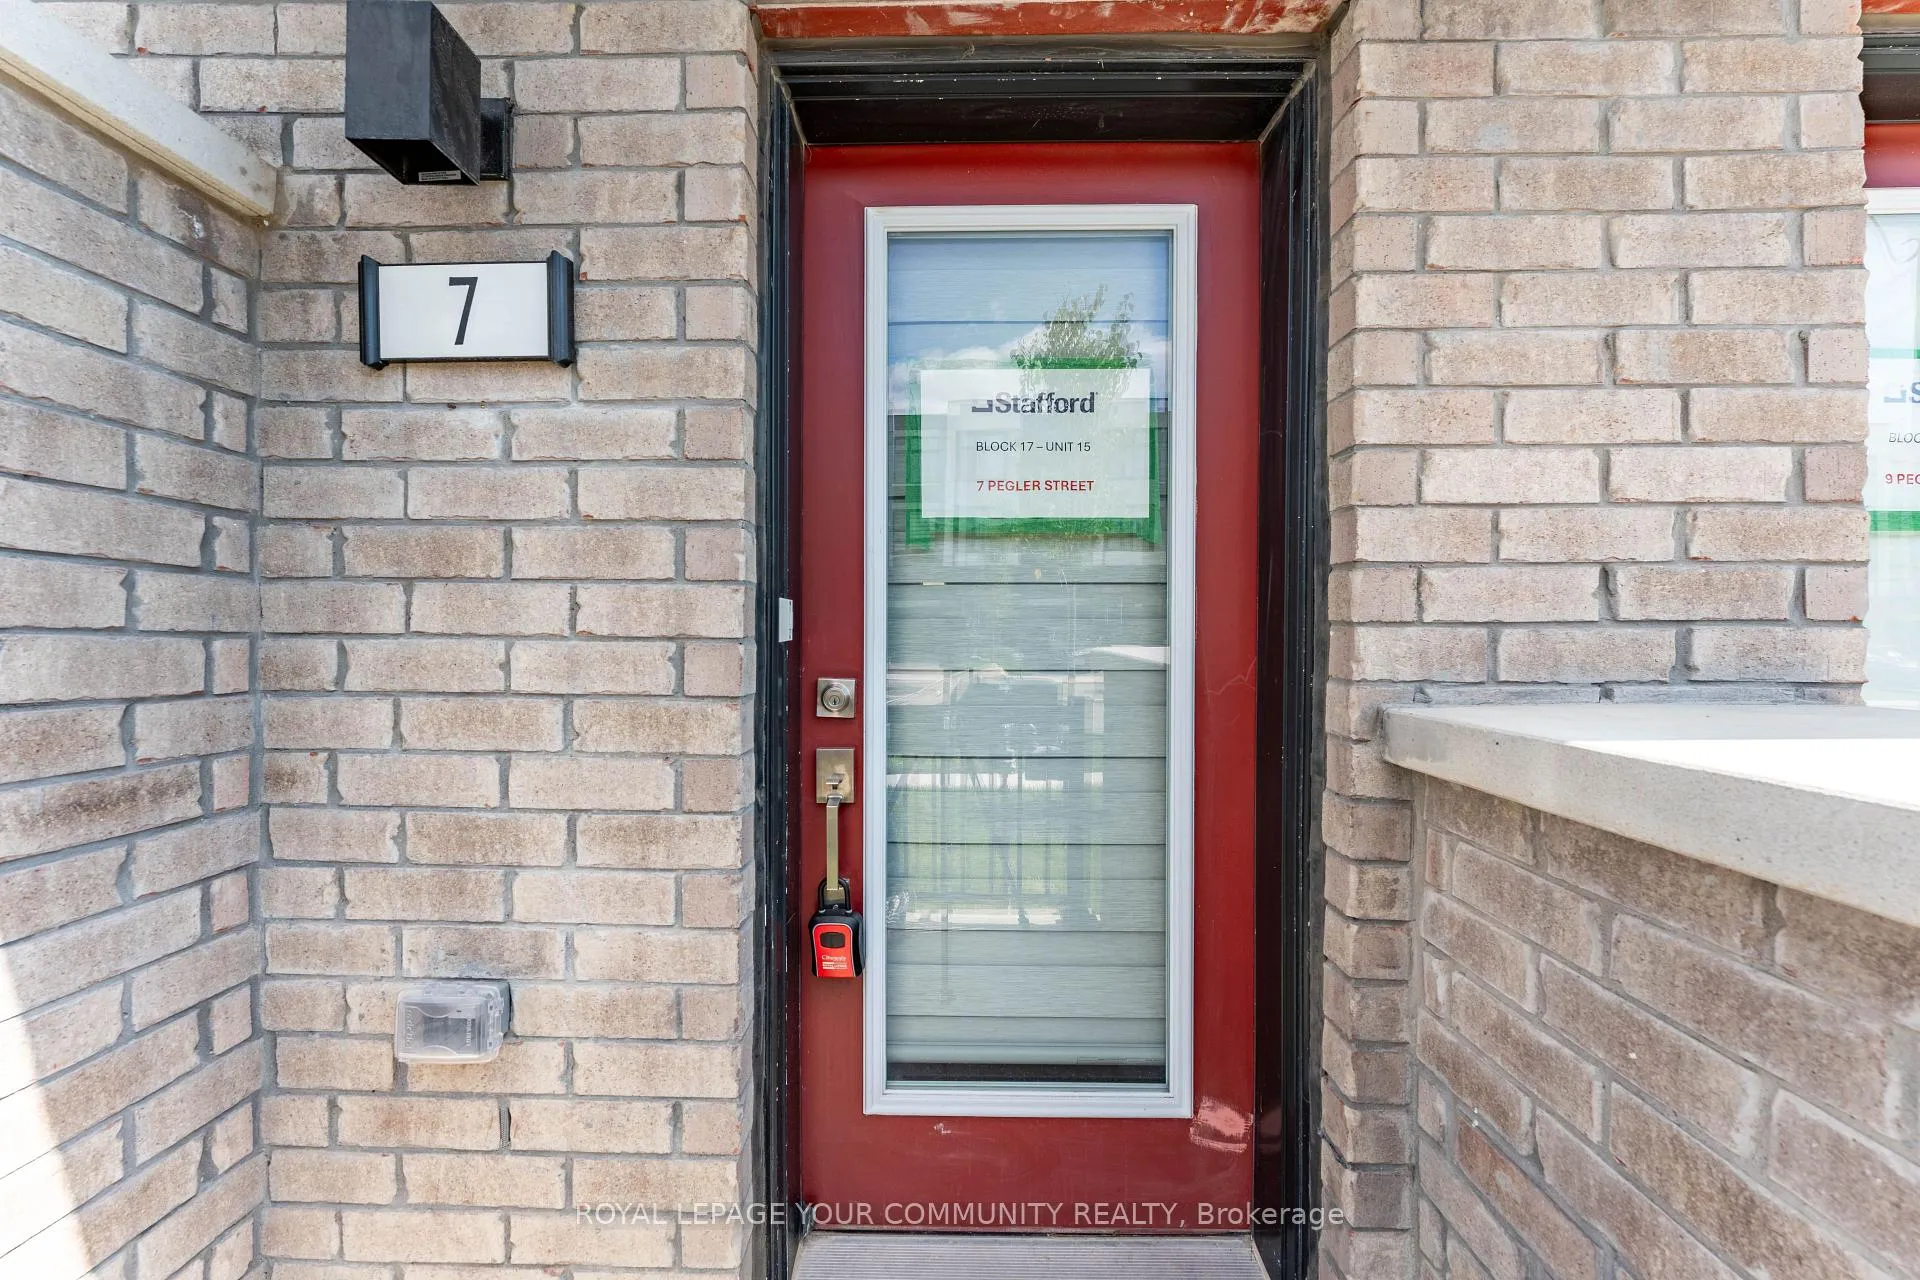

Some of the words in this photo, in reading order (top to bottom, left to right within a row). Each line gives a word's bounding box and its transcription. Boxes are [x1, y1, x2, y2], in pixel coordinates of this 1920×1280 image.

[448, 276, 479, 346] 7
[995, 391, 1095, 414] Stafford
[976, 441, 1017, 452] BLOCK
[1020, 441, 1034, 452] 17
[1045, 441, 1074, 452] UNIT
[1077, 441, 1091, 452] 15
[1885, 473, 1893, 484] 9
[976, 480, 984, 491] 7
[988, 480, 1041, 491] PEGLER
[1044, 480, 1094, 491] STREET
